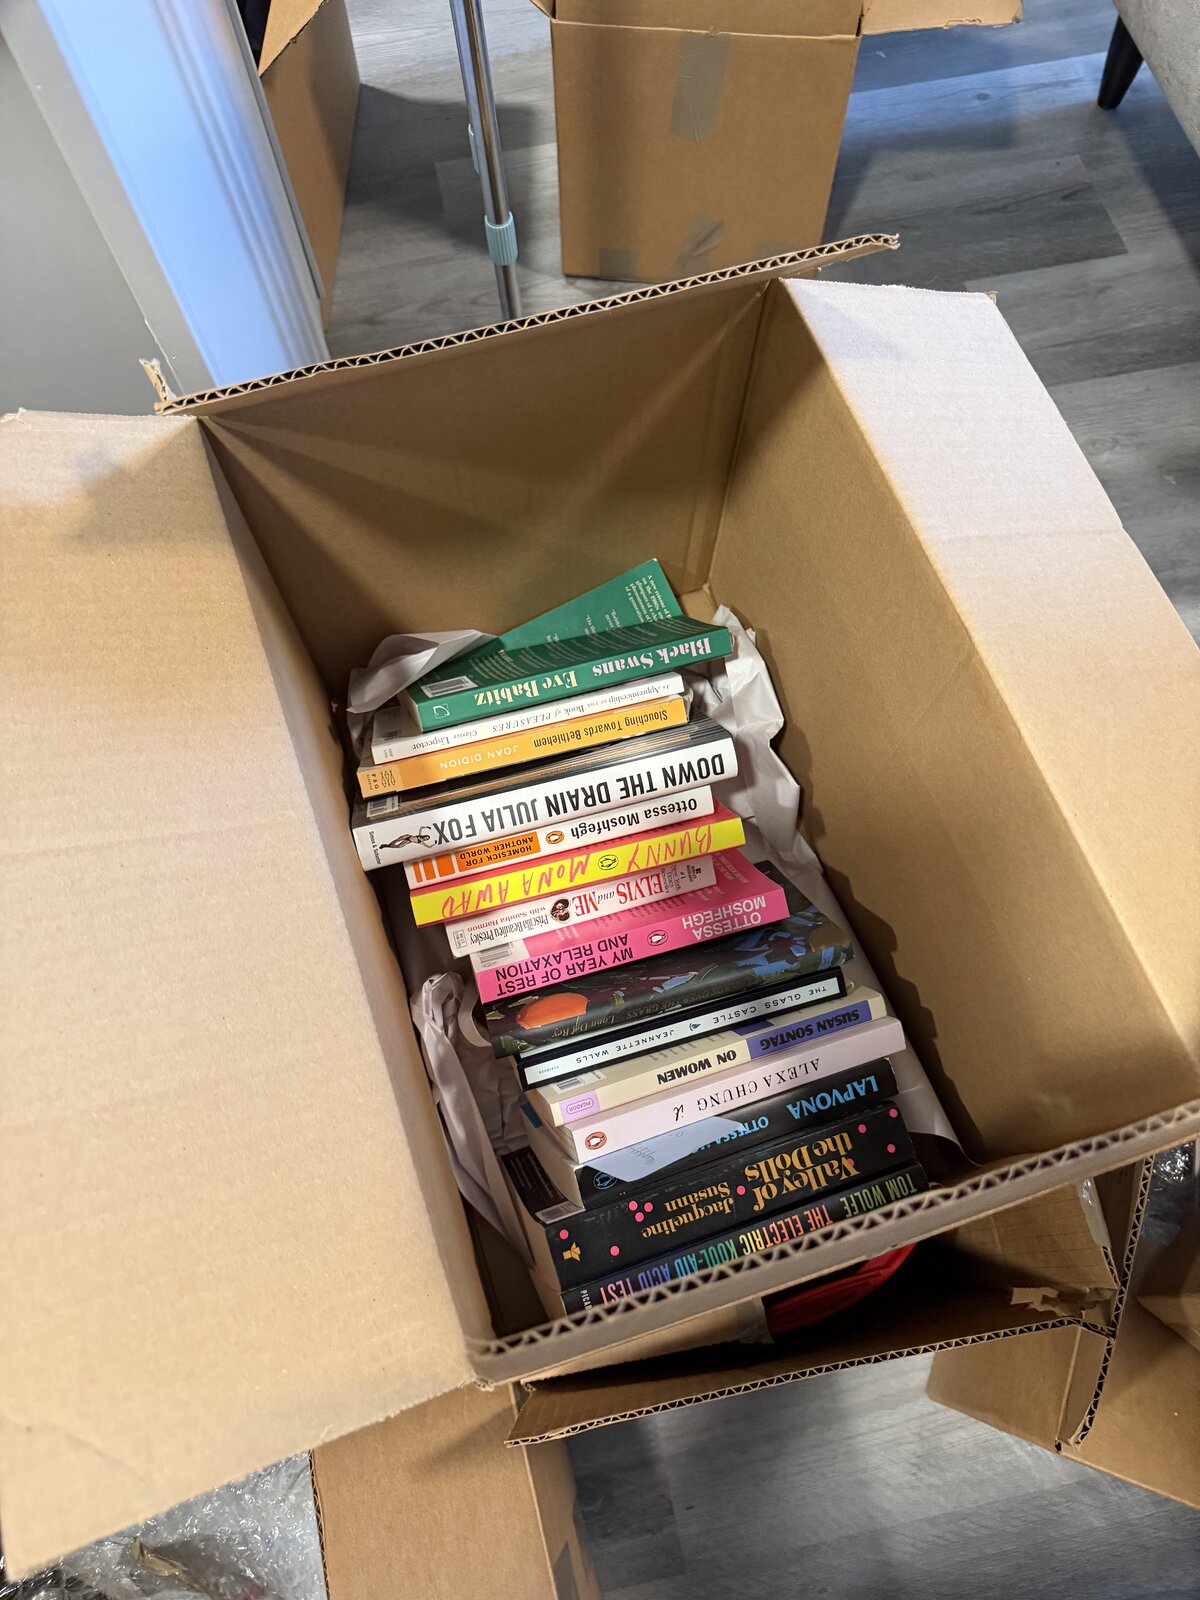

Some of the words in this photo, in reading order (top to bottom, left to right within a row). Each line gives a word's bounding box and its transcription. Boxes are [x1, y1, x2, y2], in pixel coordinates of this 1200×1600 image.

[655, 636, 711, 664] Black
[591, 651, 654, 676] Swans
[540, 670, 577, 690] Eve
[473, 679, 540, 707] Babitz
[607, 685, 659, 707] Apprenticeship
[491, 711, 551, 732] PLEASURES
[562, 703, 584, 717] Book
[624, 709, 668, 728] Slouching
[532, 728, 581, 750] Bethlehem
[582, 720, 622, 739] Towards
[411, 735, 450, 751] Lispector
[486, 743, 519, 759] JOAN
[438, 752, 481, 769] DIDION
[660, 753, 725, 788] DOWN
[615, 770, 657, 799] THE
[543, 781, 611, 818] DRAIN
[643, 797, 698, 819] Ottessa
[480, 798, 536, 832] JULIA
[569, 812, 640, 839] Moshfegh
[432, 813, 477, 845] FOX
[368, 830, 376, 844] Simon
[372, 848, 381, 865] Schuster
[458, 846, 490, 860] WORLD
[484, 844, 531, 862] HOMESICK
[492, 835, 533, 852] ANOTHER
[626, 823, 710, 872] BUNNY
[464, 856, 483, 866] FOR
[521, 852, 589, 896] MONA
[440, 879, 508, 918] AWAD
[596, 890, 614, 903] and
[614, 872, 663, 904] ELVIS
[528, 905, 546, 916] with
[571, 890, 598, 916] ME
[680, 894, 766, 929] MOSHFEGH
[466, 918, 498, 932] Harmon
[499, 910, 527, 923] Sandra
[521, 913, 549, 932] Priscilla
[691, 910, 762, 939] OTTESSA
[470, 930, 494, 945] Presley
[493, 921, 523, 939] Beaulieu
[596, 932, 627, 952] AND
[494, 943, 593, 980] RELAXATION
[564, 954, 607, 976] YEAR
[611, 946, 633, 963] MY
[494, 974, 536, 996] REST
[540, 967, 561, 982] OF
[763, 992, 800, 1009] GLASS
[807, 985, 826, 996] THE
[712, 1005, 756, 1023] CASTLE
[815, 1008, 860, 1032] SUSAN
[551, 1027, 568, 1037] Rey
[614, 1028, 674, 1052] JEANNETTE
[758, 1023, 813, 1050] SONTAG
[574, 1049, 609, 1064] WALLS
[715, 1049, 737, 1065] ON
[656, 1057, 711, 1085] WOMEN
[761, 1057, 819, 1088] ALEXA
[567, 1099, 591, 1113] PICADOR
[696, 1079, 758, 1111] CHUNG
[785, 1074, 878, 1119] LAPVONA
[672, 1104, 682, 1121] it
[811, 1131, 852, 1157] the
[743, 1144, 815, 1183] Dolls
[781, 1155, 860, 1194] Valley
[663, 1180, 731, 1212] Susann
[751, 1181, 777, 1211] of
[884, 1172, 917, 1200] TOM
[838, 1183, 886, 1217] WOLFE
[640, 1196, 733, 1238] Jacqueline
[802, 1203, 833, 1231] THE
[737, 1214, 804, 1255] ELECTRIC
[672, 1238, 738, 1279] KOOL-AID
[636, 1262, 669, 1290] ACID
[580, 1288, 592, 1310] PICAD
[598, 1276, 634, 1305] TEST
